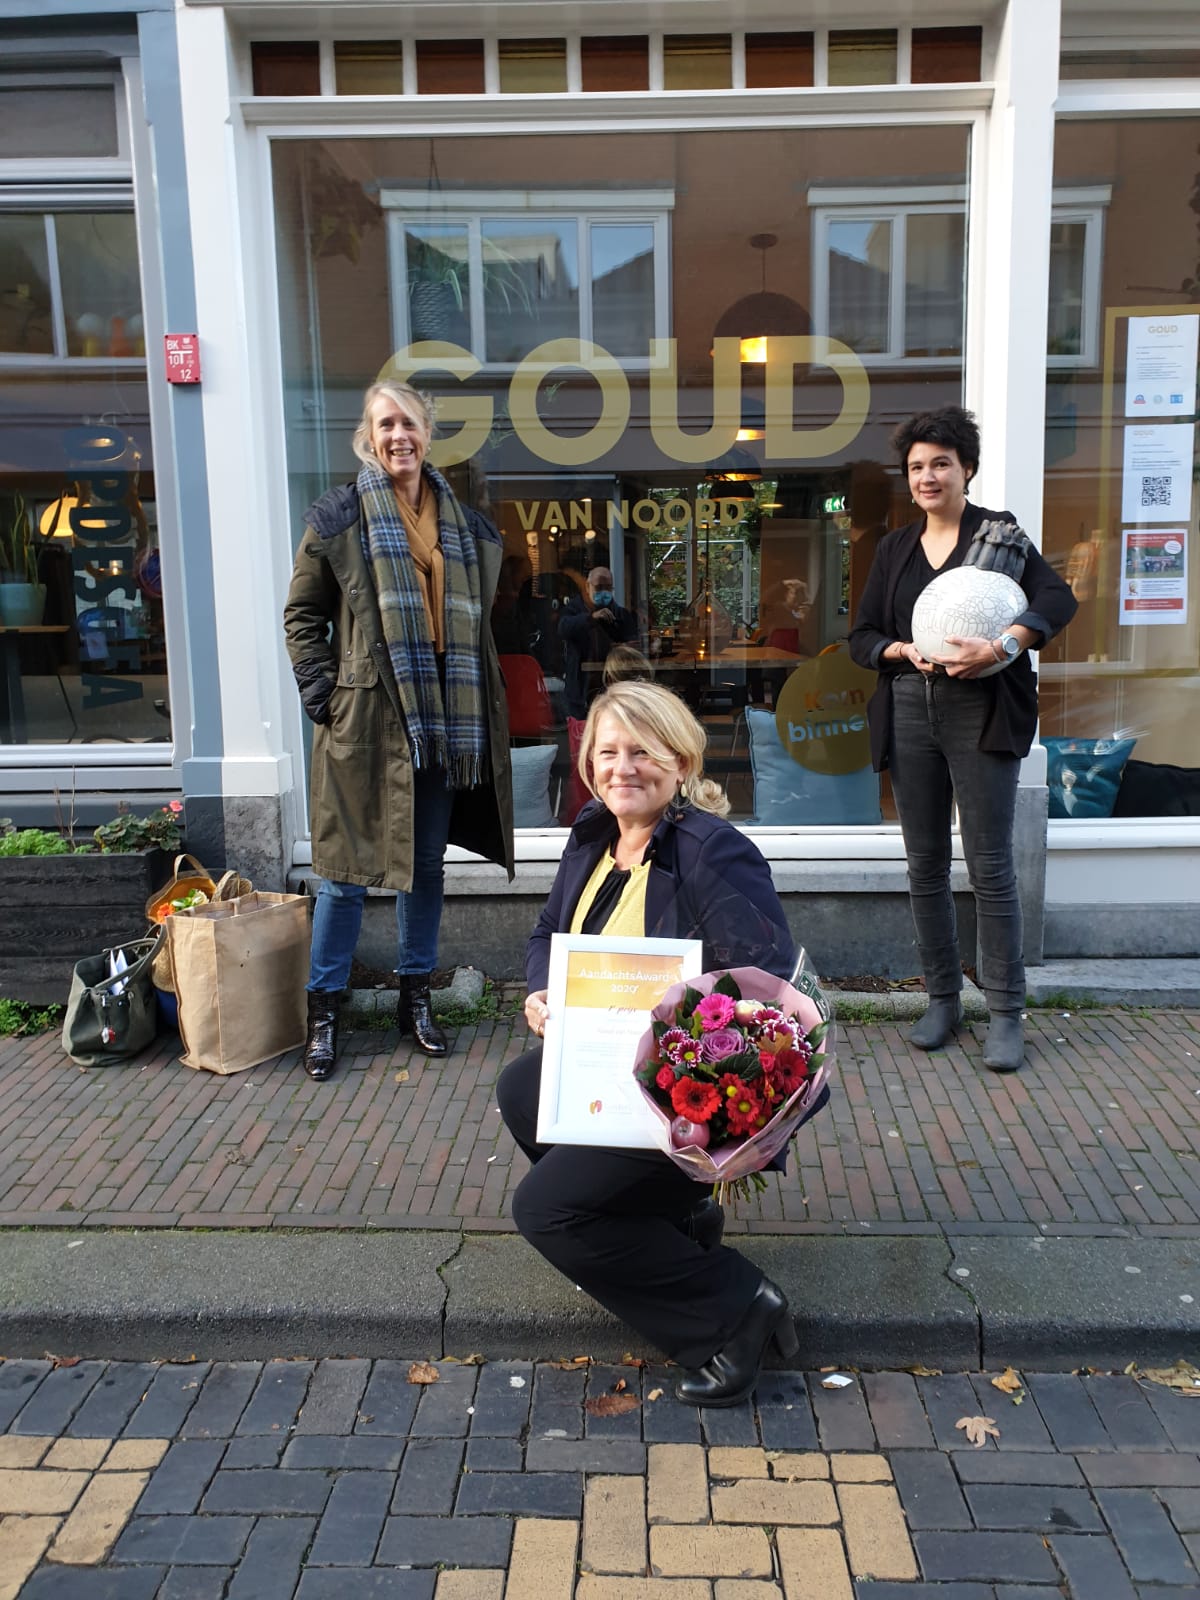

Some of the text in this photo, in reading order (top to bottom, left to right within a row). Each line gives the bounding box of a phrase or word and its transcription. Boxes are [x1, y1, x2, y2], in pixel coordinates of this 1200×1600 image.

[166, 339, 179, 350] BK
[376, 336, 871, 467] GOUD
[515, 497, 745, 531] VAN NOORD
[788, 715, 869, 742] binne
